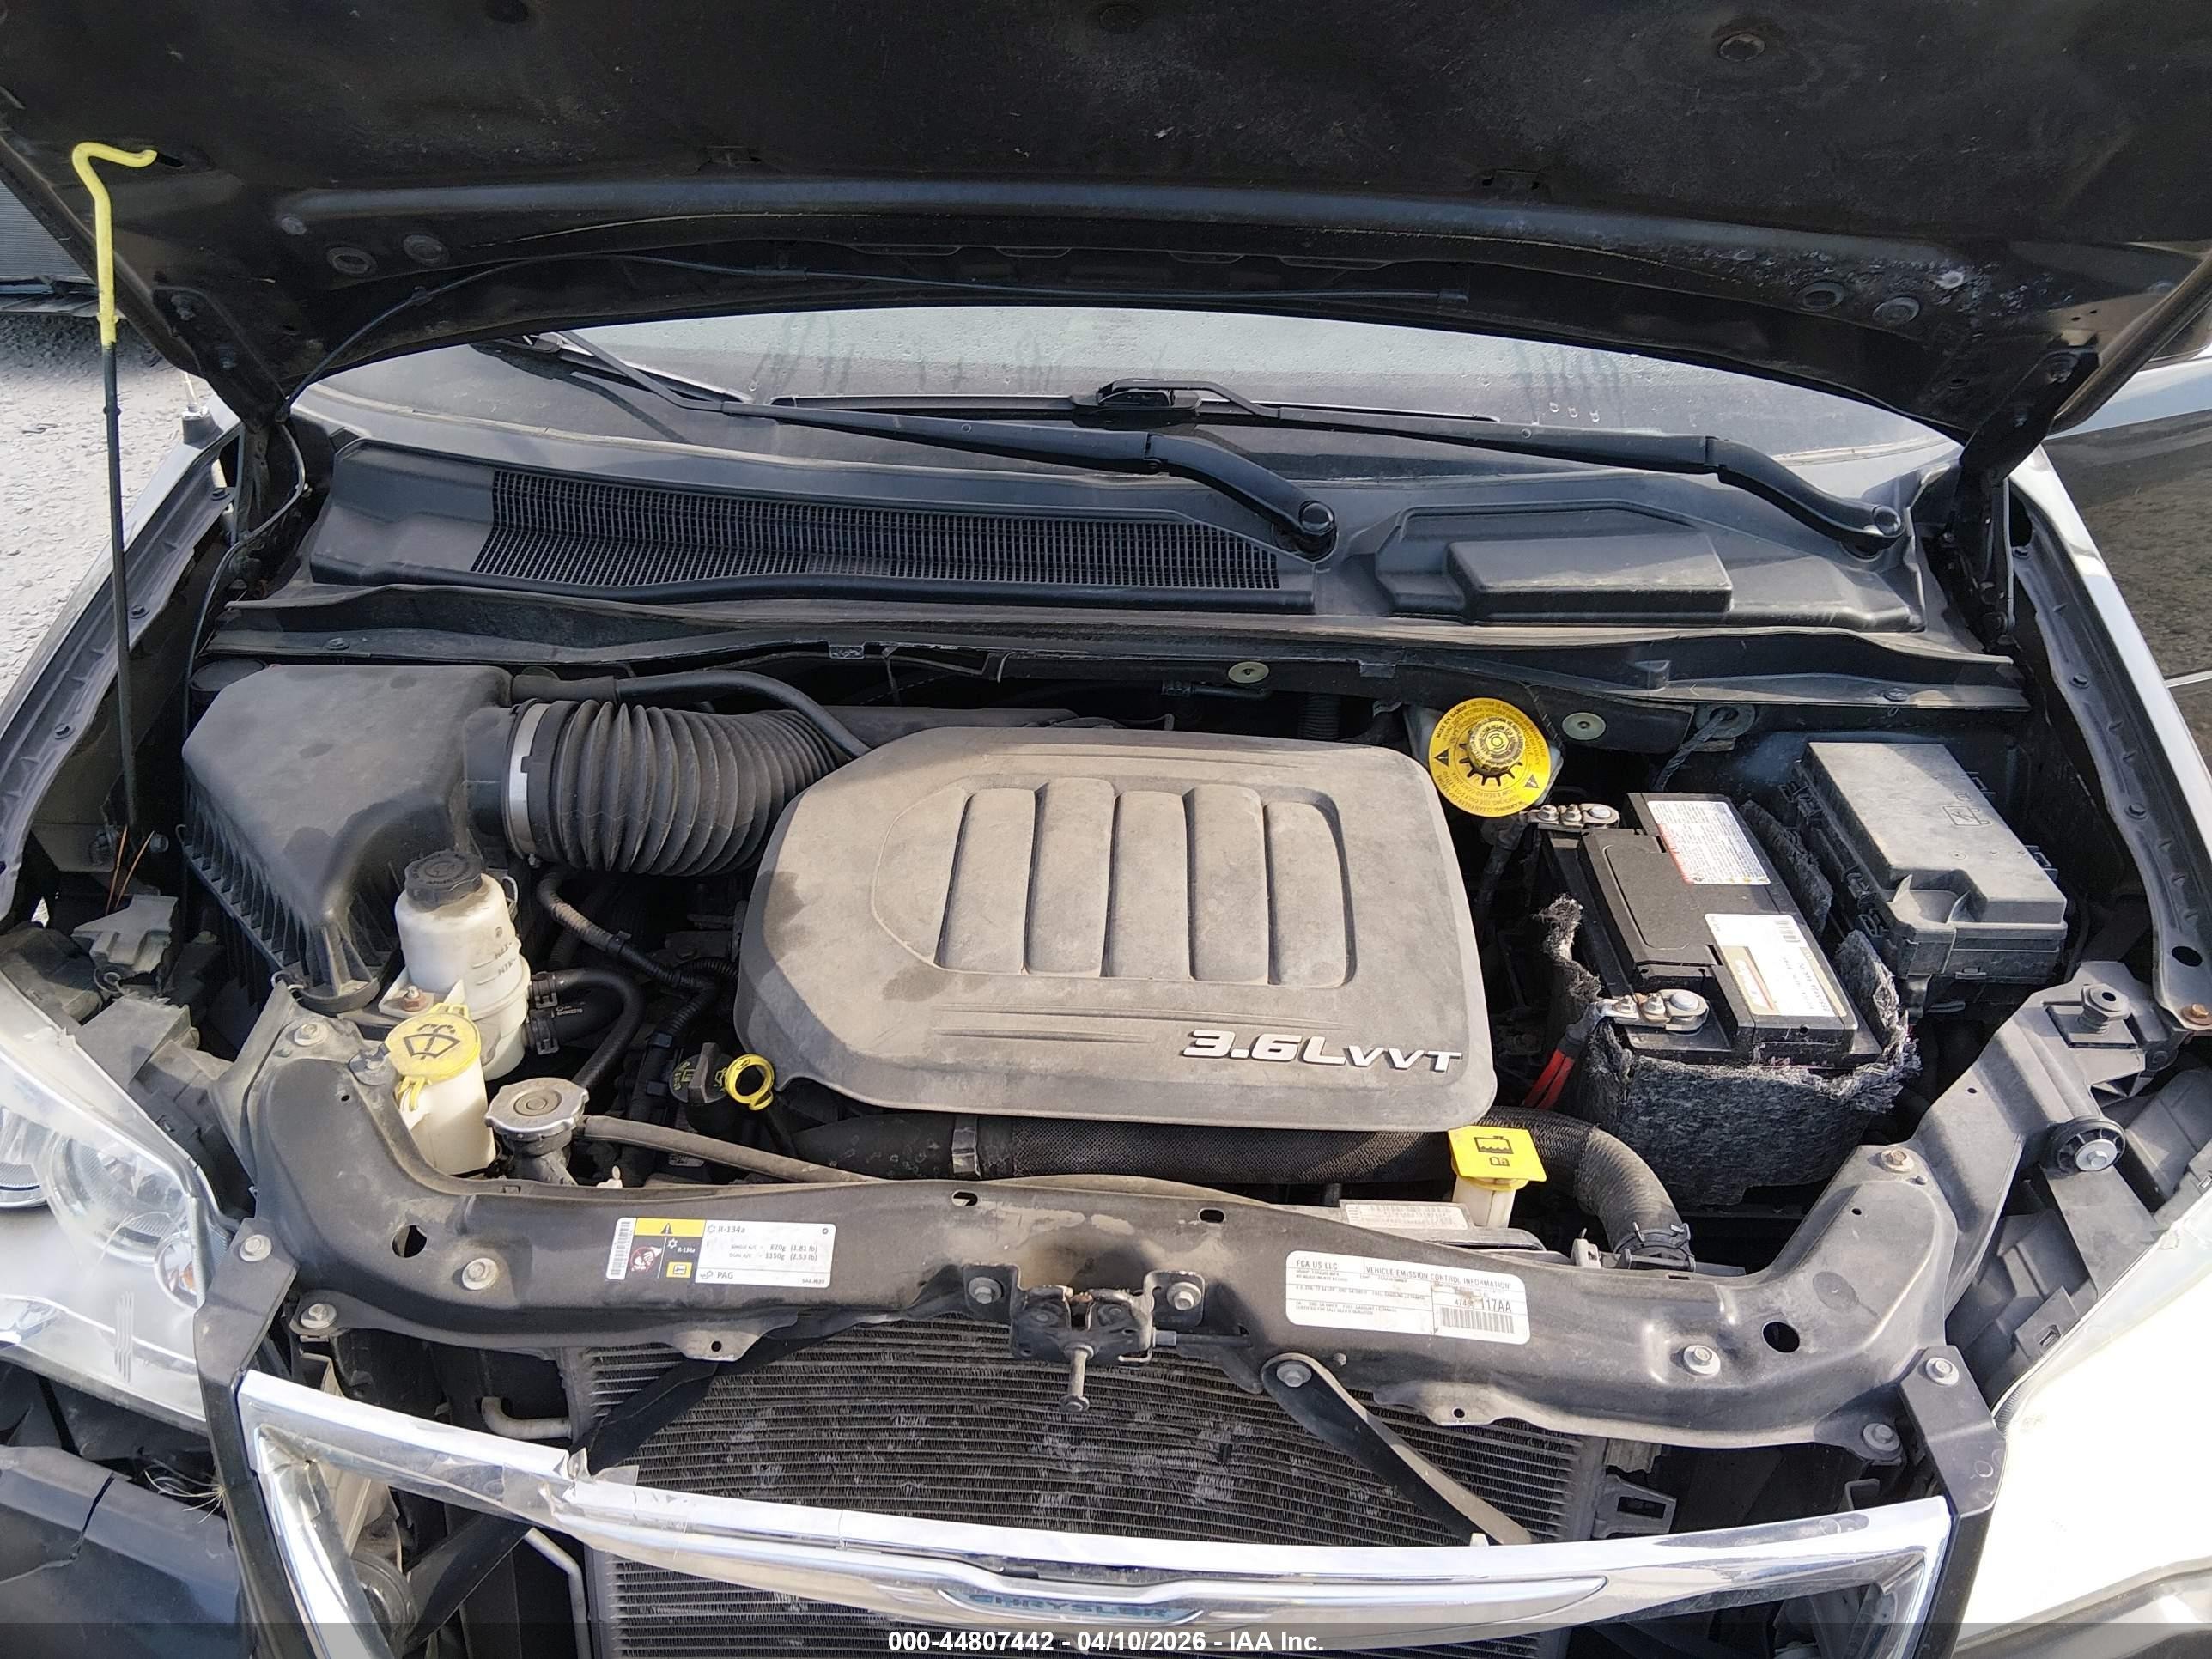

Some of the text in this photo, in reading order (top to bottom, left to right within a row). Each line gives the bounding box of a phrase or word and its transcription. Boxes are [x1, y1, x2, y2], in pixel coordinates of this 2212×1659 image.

[1346, 1045, 1463, 1073] VVT
[1297, 1260, 1310, 1268] FCA
[1312, 1261, 1322, 1269] US
[1324, 1261, 1338, 1270] LLC
[1366, 1266, 1393, 1276] VEHICLE
[1396, 1268, 1428, 1279] EMISSION
[1431, 1273, 1461, 1285] CONTROL
[1463, 1277, 1510, 1290] INFORMATION
[969, 1593, 1169, 1617] CHRYSLER
